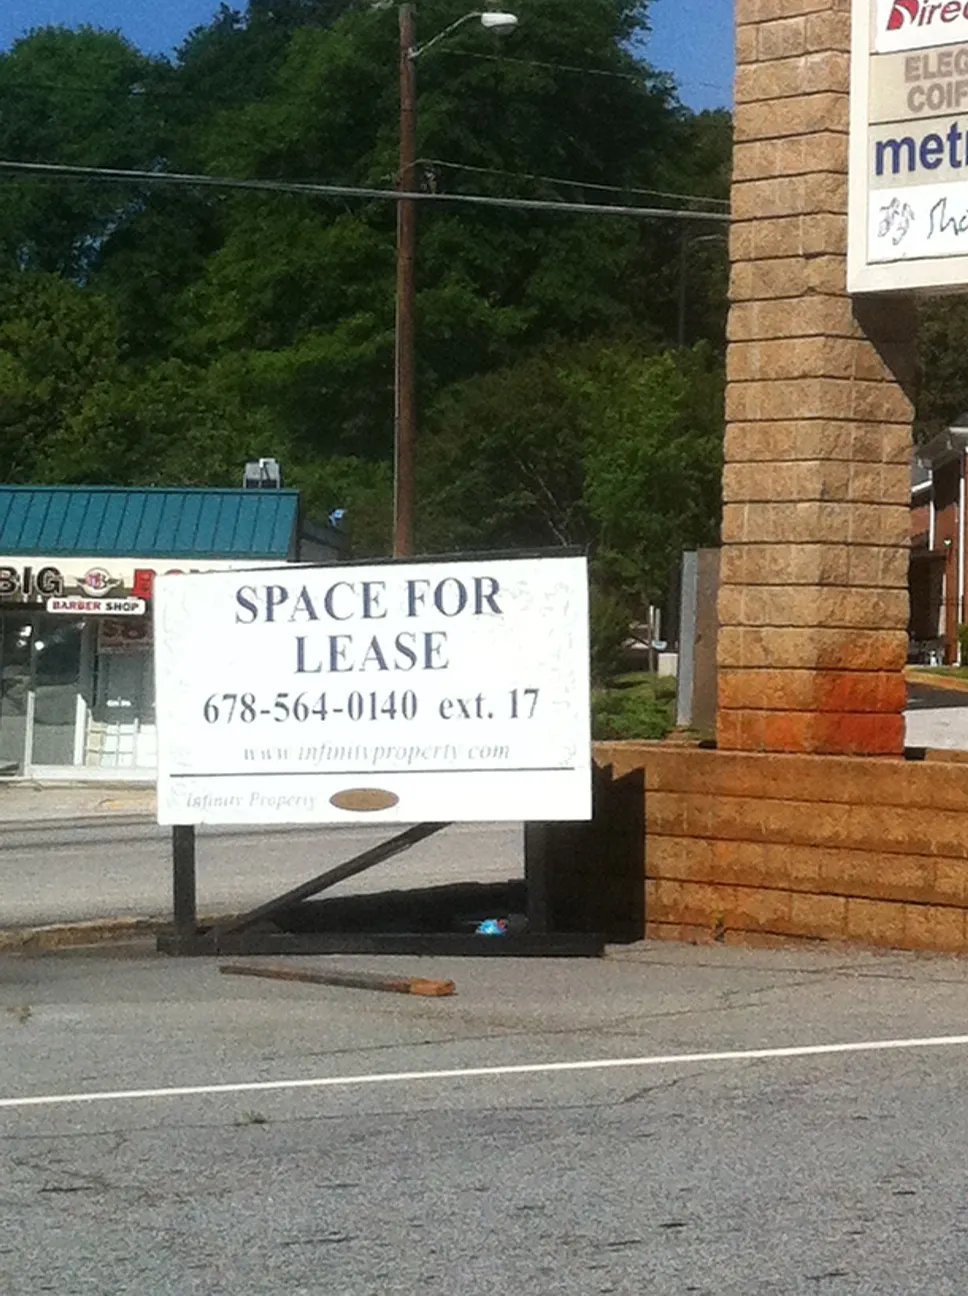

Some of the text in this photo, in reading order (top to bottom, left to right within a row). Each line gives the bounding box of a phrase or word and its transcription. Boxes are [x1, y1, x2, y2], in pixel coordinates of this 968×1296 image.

[0, 566, 64, 596] BIG
[53, 601, 139, 611] BARBER SHOP
[234, 576, 503, 624] SPACE FOR
[294, 631, 450, 674] LEASE
[203, 688, 541, 724] 678-564-0140 ext. 17
